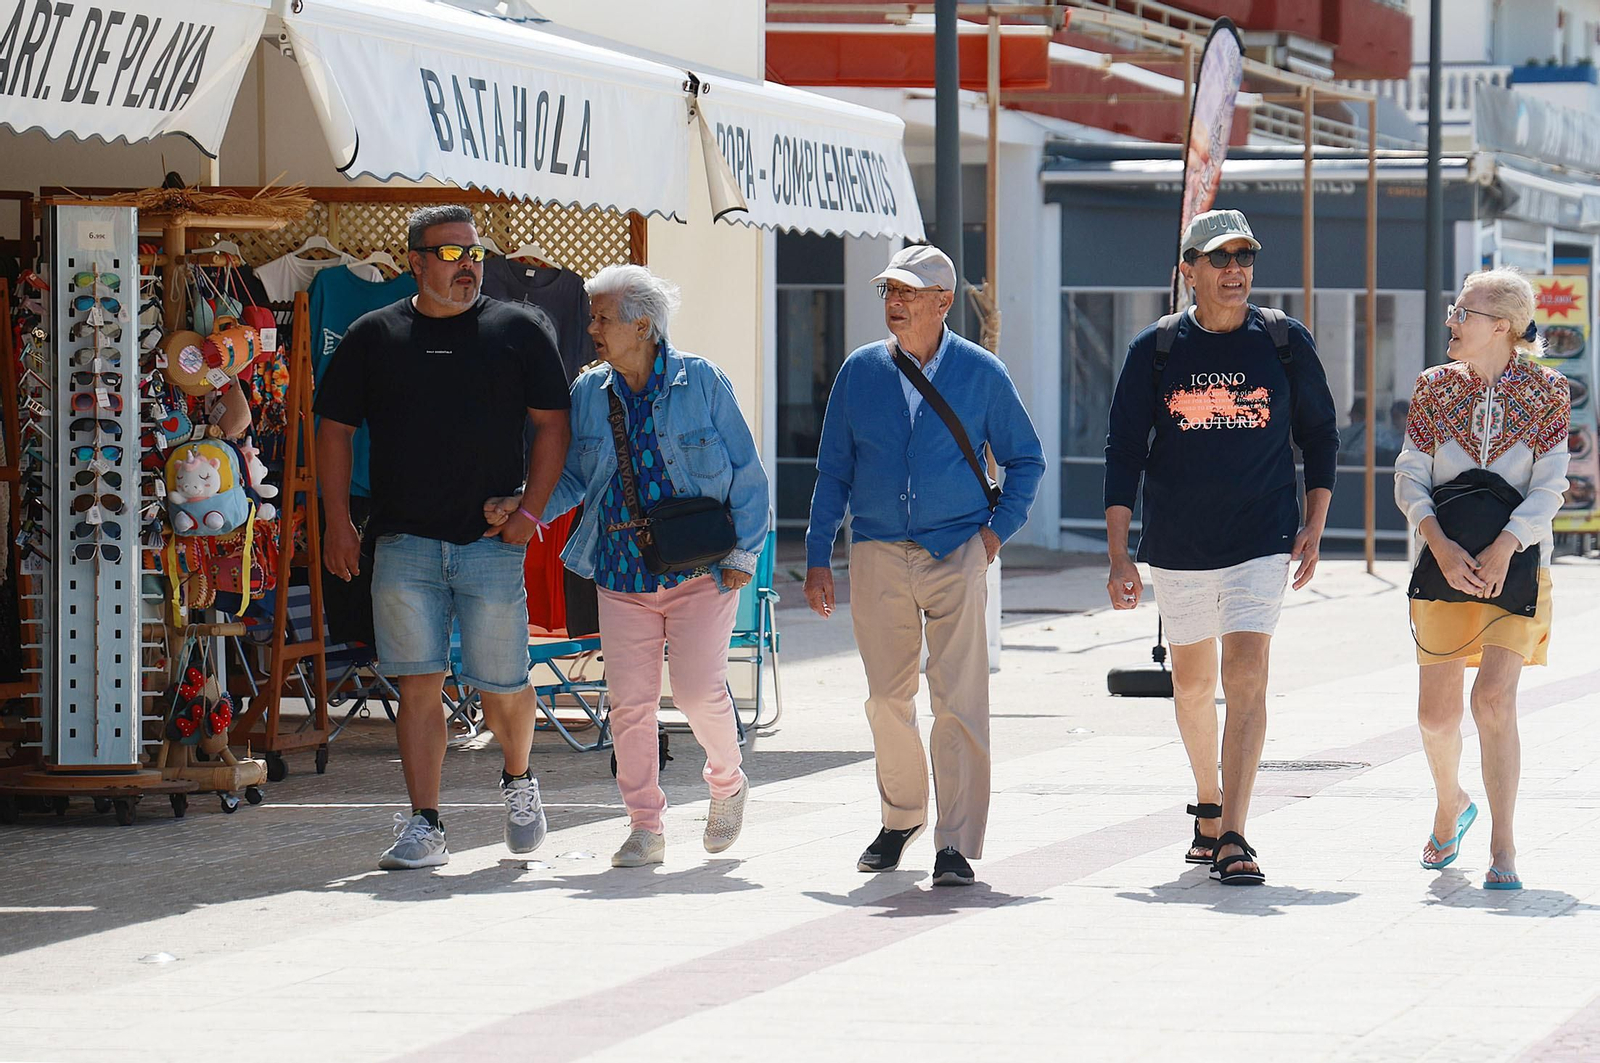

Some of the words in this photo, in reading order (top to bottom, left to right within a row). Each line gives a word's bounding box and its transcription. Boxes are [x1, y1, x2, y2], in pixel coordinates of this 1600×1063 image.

[0, 0, 74, 100] ART.
[61, 7, 126, 105] DE
[106, 14, 215, 112] PLAYA
[420, 67, 591, 178] BATAHOLA
[772, 133, 897, 217] COMPLEMENTOS
[1190, 372, 1246, 386] ICONO
[1180, 415, 1258, 430] COUTURE
